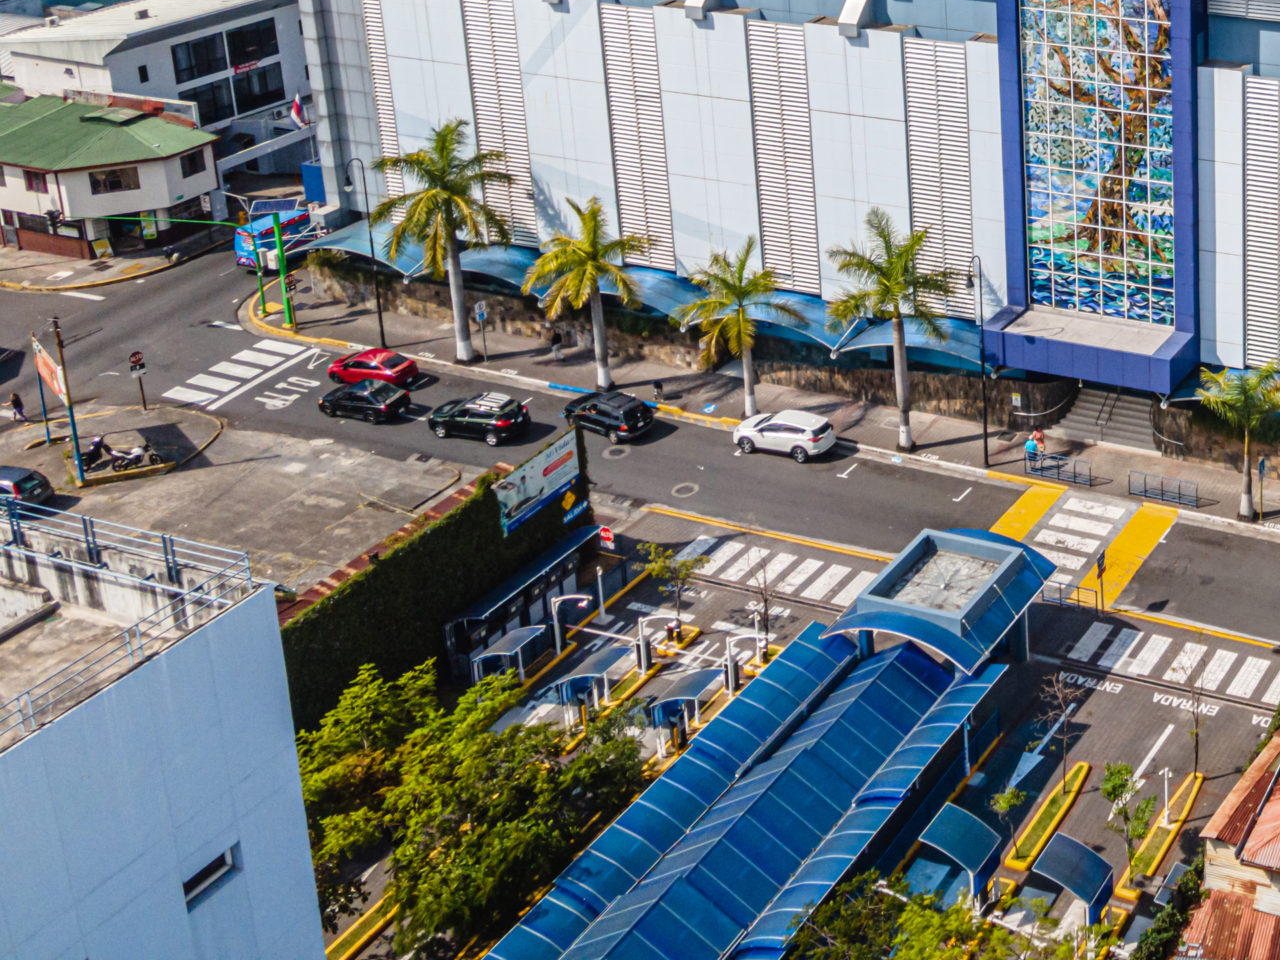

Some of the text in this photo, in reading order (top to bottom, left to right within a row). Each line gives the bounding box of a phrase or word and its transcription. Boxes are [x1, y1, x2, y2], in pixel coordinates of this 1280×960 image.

[254, 376, 320, 410] ALTO
[1058, 671, 1124, 694] ENTRADA
[1152, 692, 1220, 717] ENTRADA
